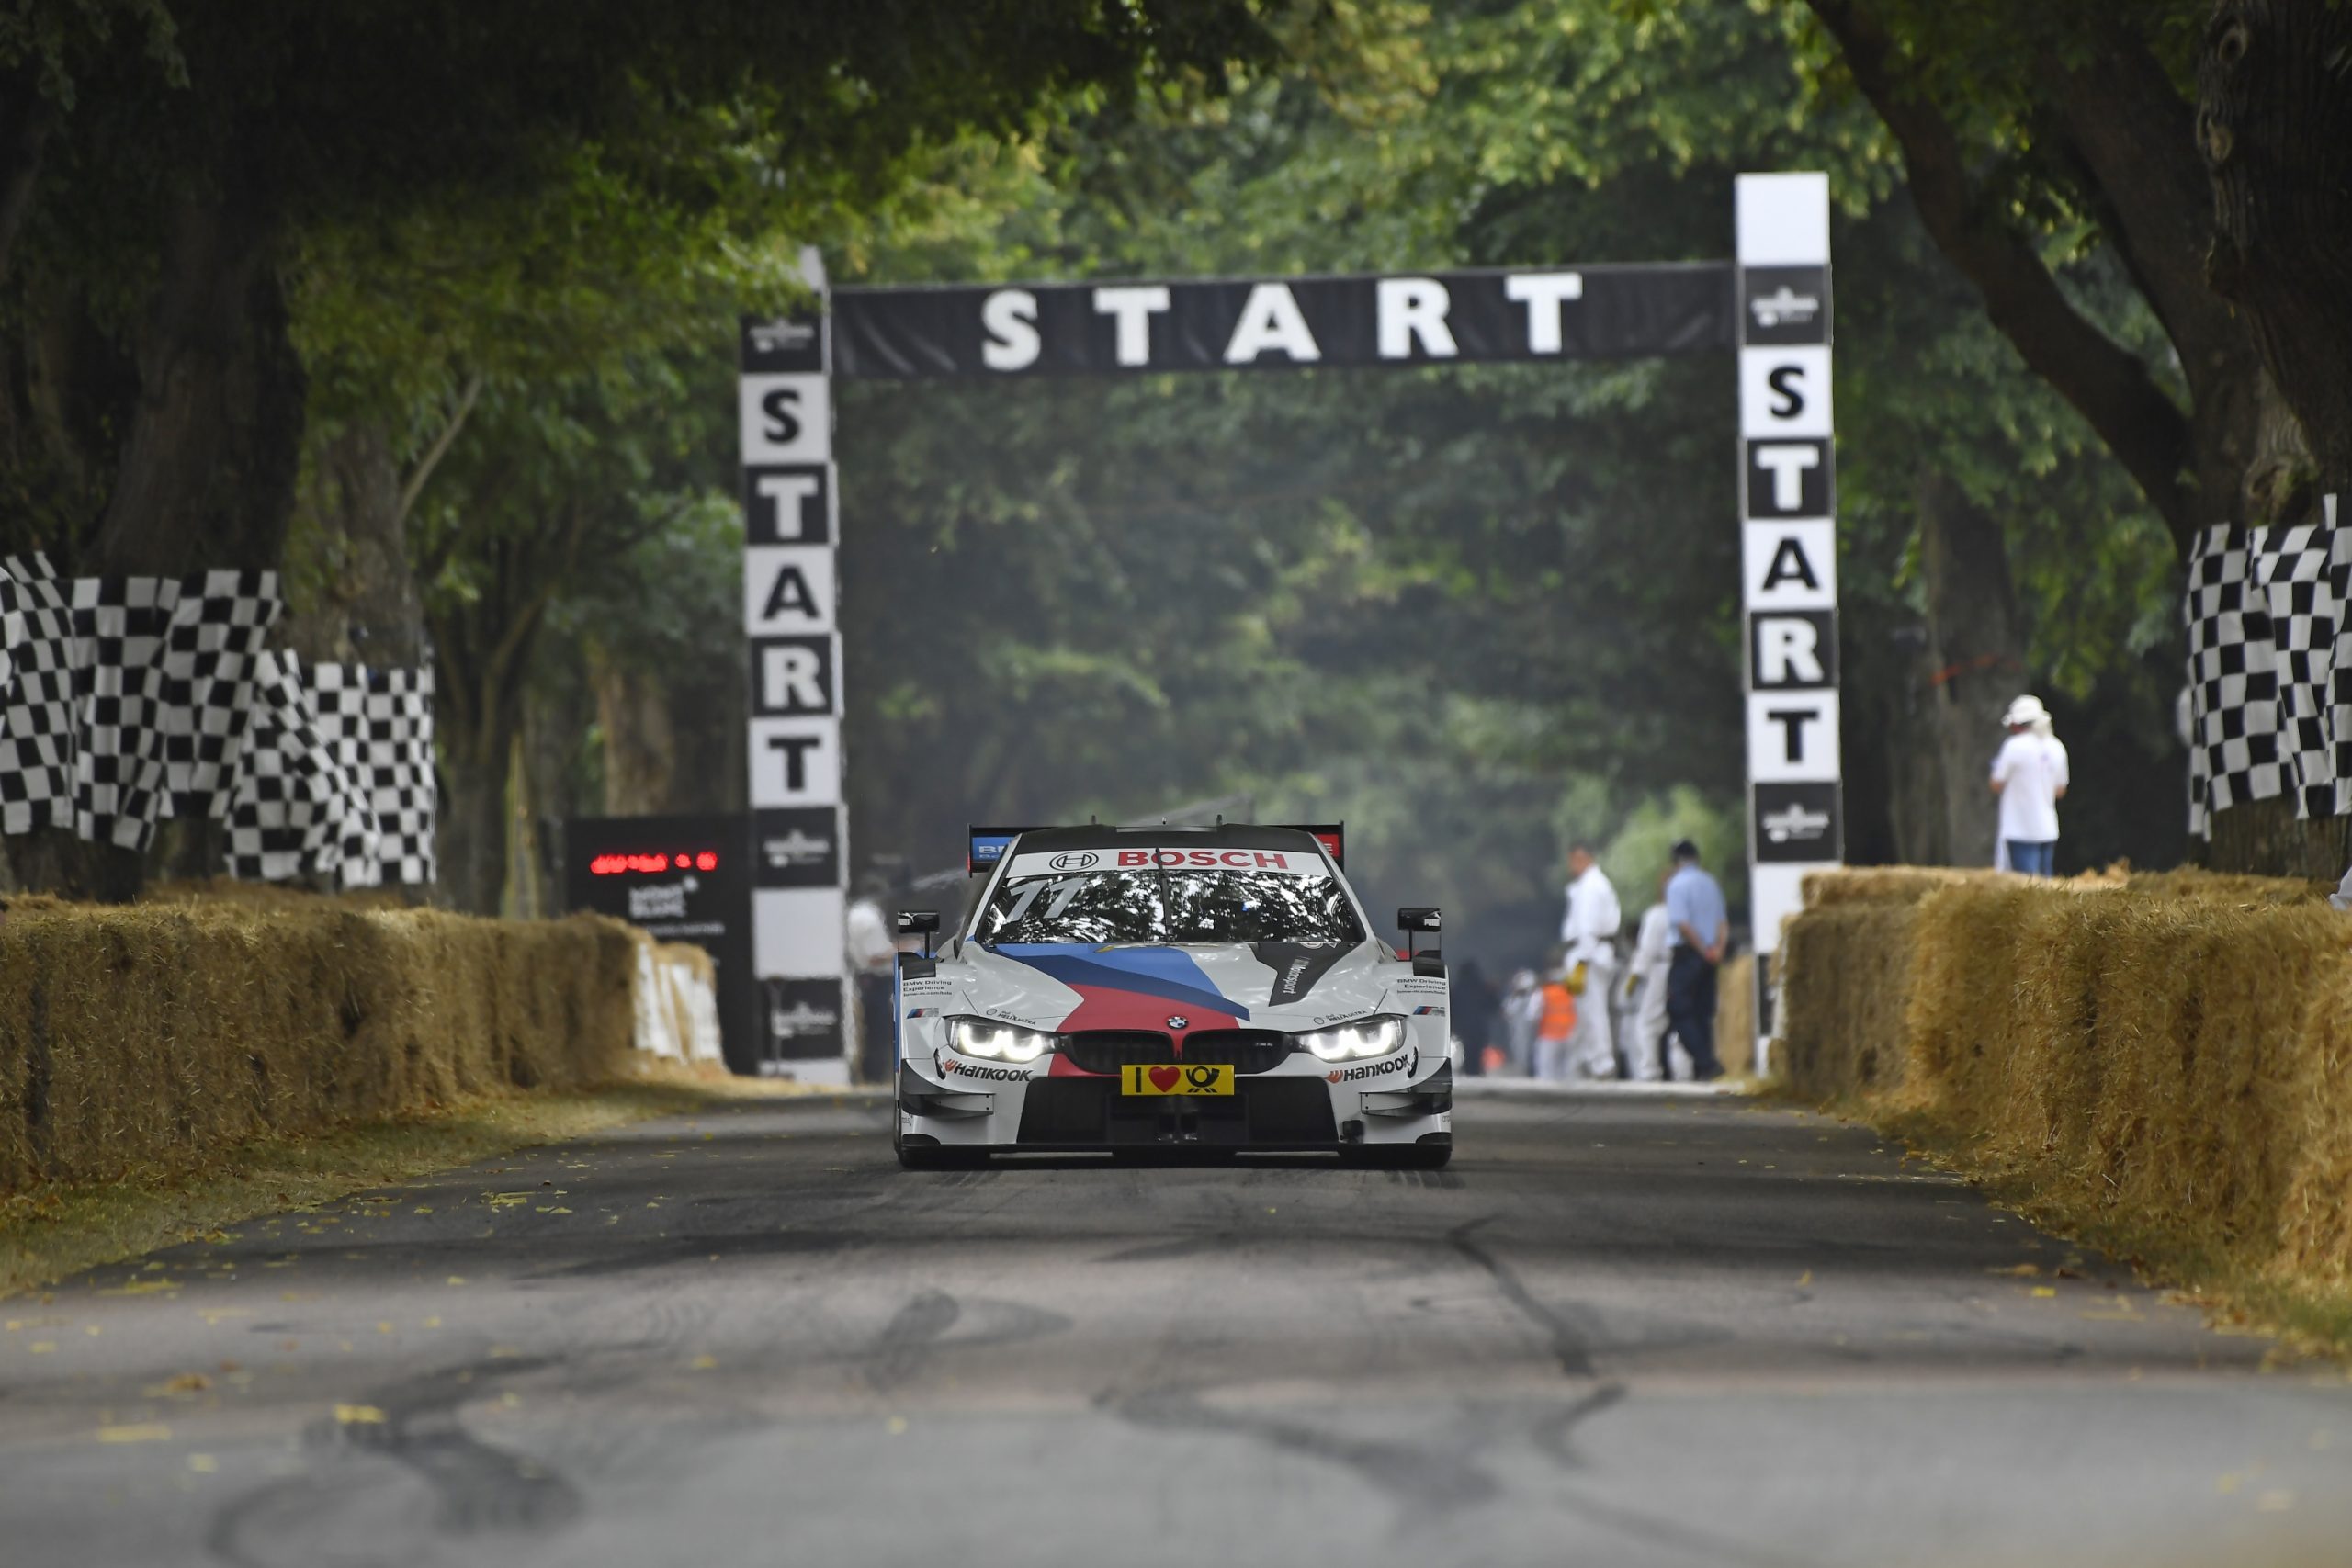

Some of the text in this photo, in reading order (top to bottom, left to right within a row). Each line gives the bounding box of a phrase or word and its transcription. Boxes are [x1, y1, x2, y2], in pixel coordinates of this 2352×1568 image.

[981, 273, 1582, 369] START
[757, 389, 826, 793] START
[1755, 366, 1824, 762] START
[1117, 850, 1288, 869] BOSCH
[1005, 877, 1088, 922] 11
[1135, 1066, 1142, 1093] I
